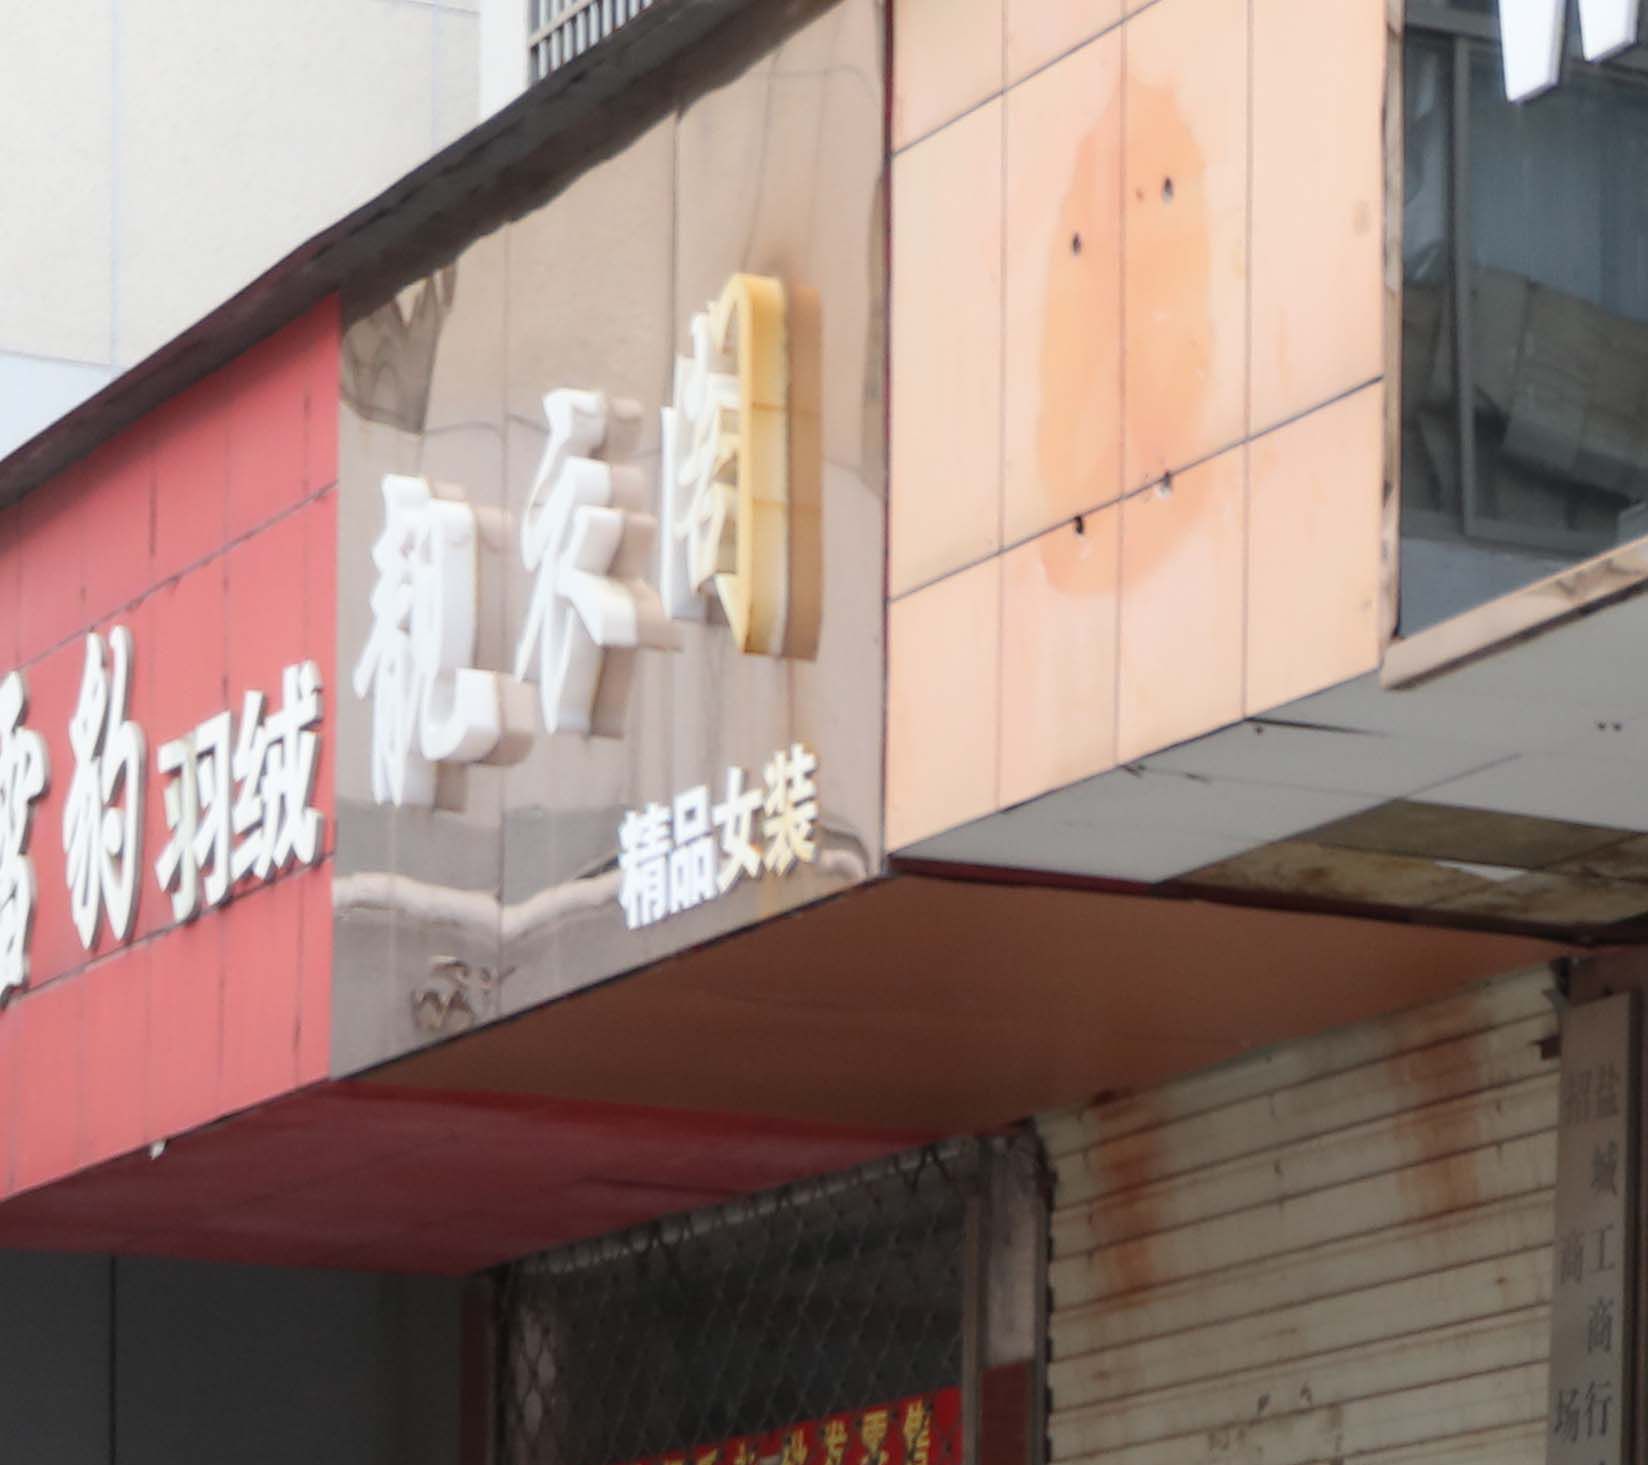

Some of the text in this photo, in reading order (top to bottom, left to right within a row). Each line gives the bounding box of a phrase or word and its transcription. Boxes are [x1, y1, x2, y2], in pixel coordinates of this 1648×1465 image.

[154, 660, 324, 922] 羽绒
[618, 742, 818, 930] 精品女装
